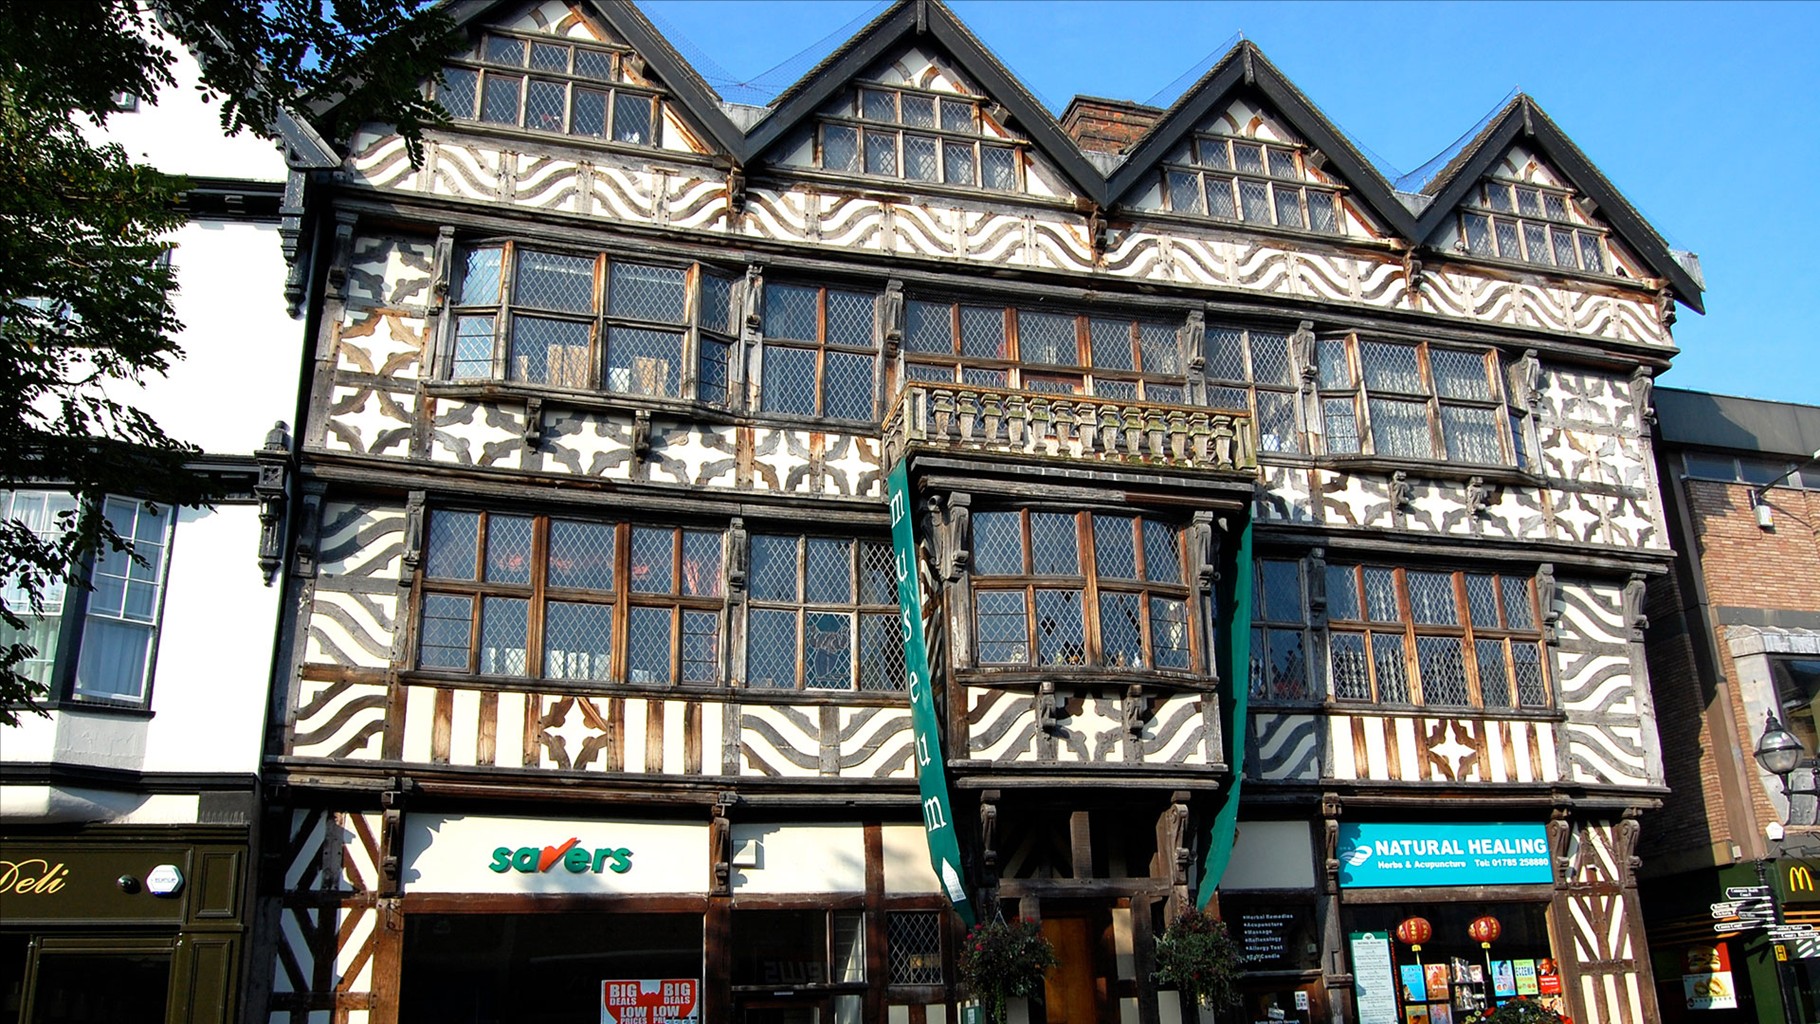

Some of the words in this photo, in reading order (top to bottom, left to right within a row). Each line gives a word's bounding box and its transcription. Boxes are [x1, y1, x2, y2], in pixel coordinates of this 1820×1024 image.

[888, 487, 945, 833] museum
[1374, 840, 1464, 856] NATURAL
[1467, 838, 1547, 854] HEALING
[488, 837, 634, 875] savers
[1377, 860, 1403, 869] Herbs
[1405, 860, 1411, 868] &
[1414, 859, 1466, 870] Acupuncture
[1491, 858, 1517, 867] 01785
[0, 858, 70, 894] Deli
[609, 984, 637, 998] BIG
[663, 982, 691, 997] BIG
[609, 997, 637, 1006] DEALS
[663, 996, 691, 1005] DEALS
[620, 1006, 648, 1018] LOW
[653, 1005, 680, 1017] LOW
